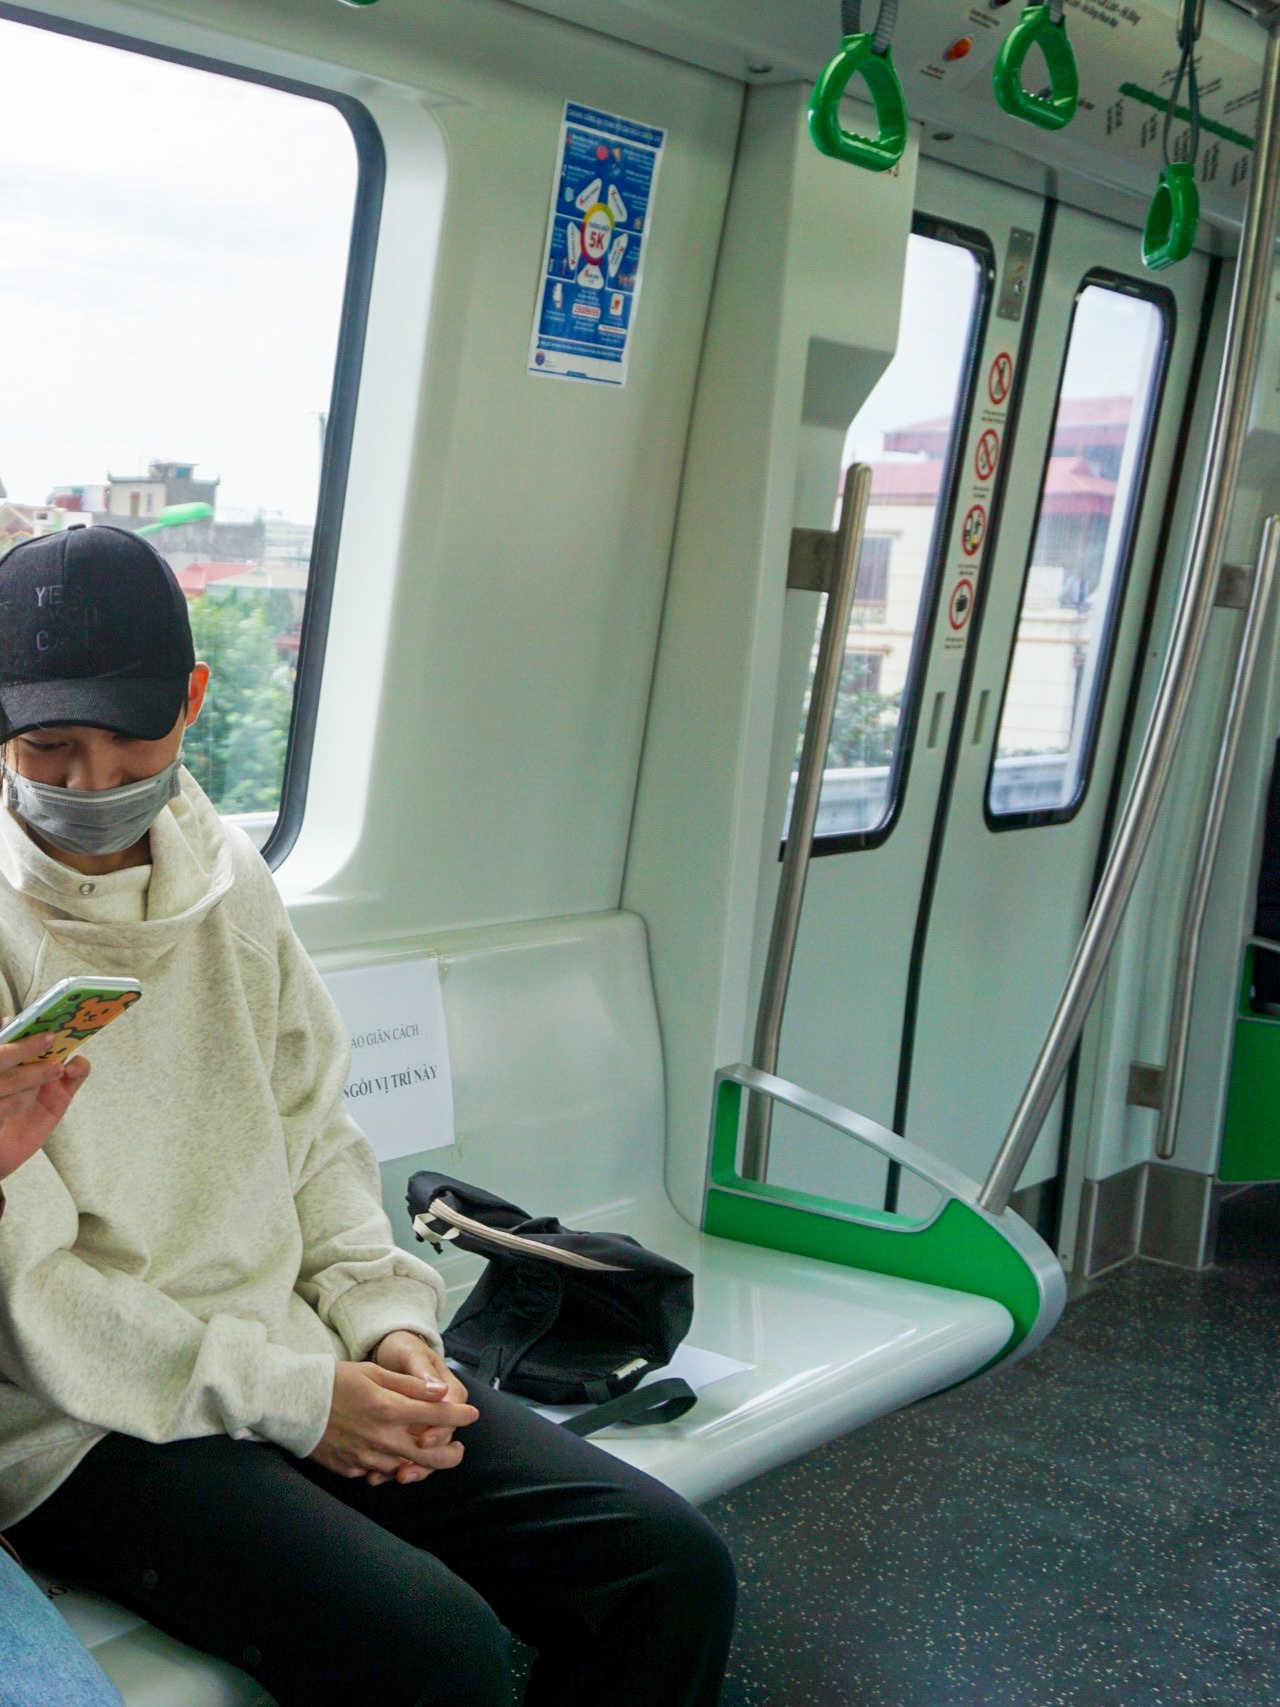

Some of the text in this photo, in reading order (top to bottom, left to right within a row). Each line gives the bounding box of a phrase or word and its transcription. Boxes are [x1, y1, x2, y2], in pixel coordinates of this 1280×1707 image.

[588, 231, 605, 250] 5K
[350, 1023, 419, 1049] ẢO GIÃN CÁCH
[375, 1076, 389, 1094] VỊ
[390, 1066, 412, 1088] TRÍ
[414, 1063, 438, 1084] NÀY
